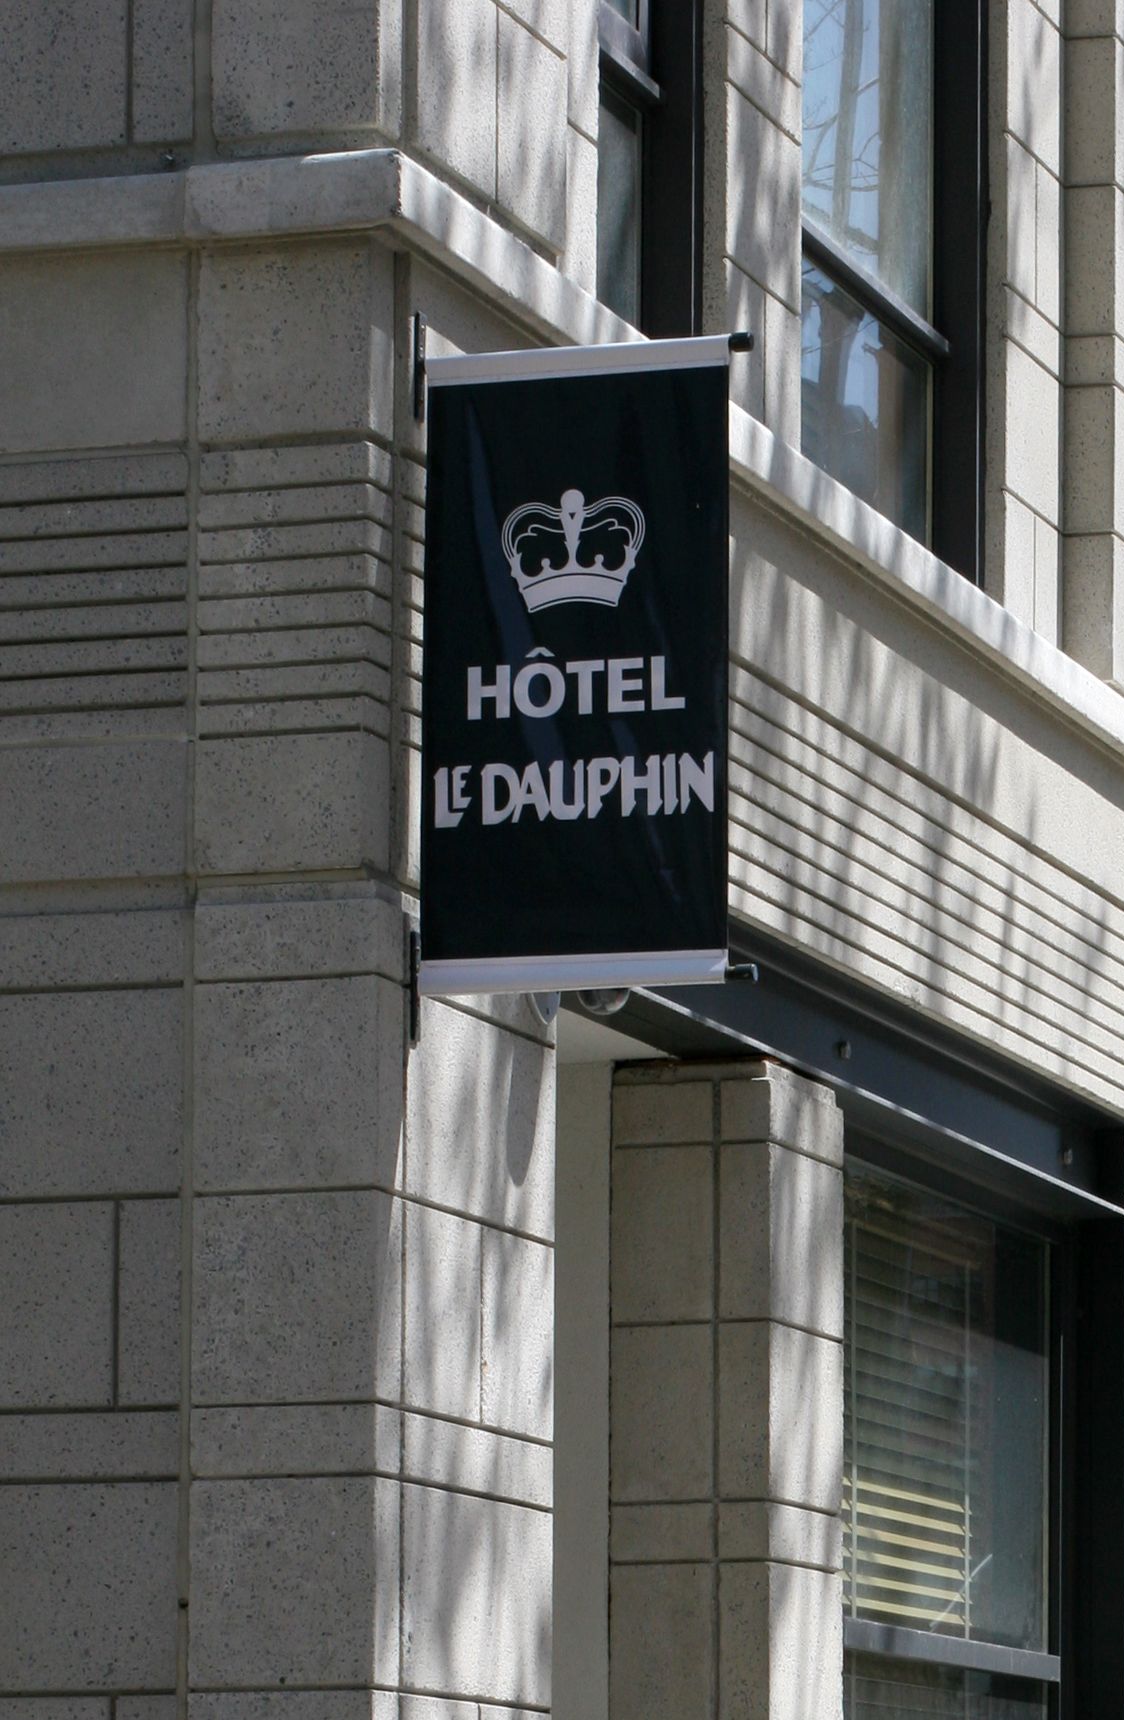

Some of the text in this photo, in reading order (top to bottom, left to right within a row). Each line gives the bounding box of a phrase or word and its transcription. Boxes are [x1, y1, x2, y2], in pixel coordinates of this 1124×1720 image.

[466, 647, 686, 721] HÔTEL
[434, 751, 715, 829] LE DAUPHIN
